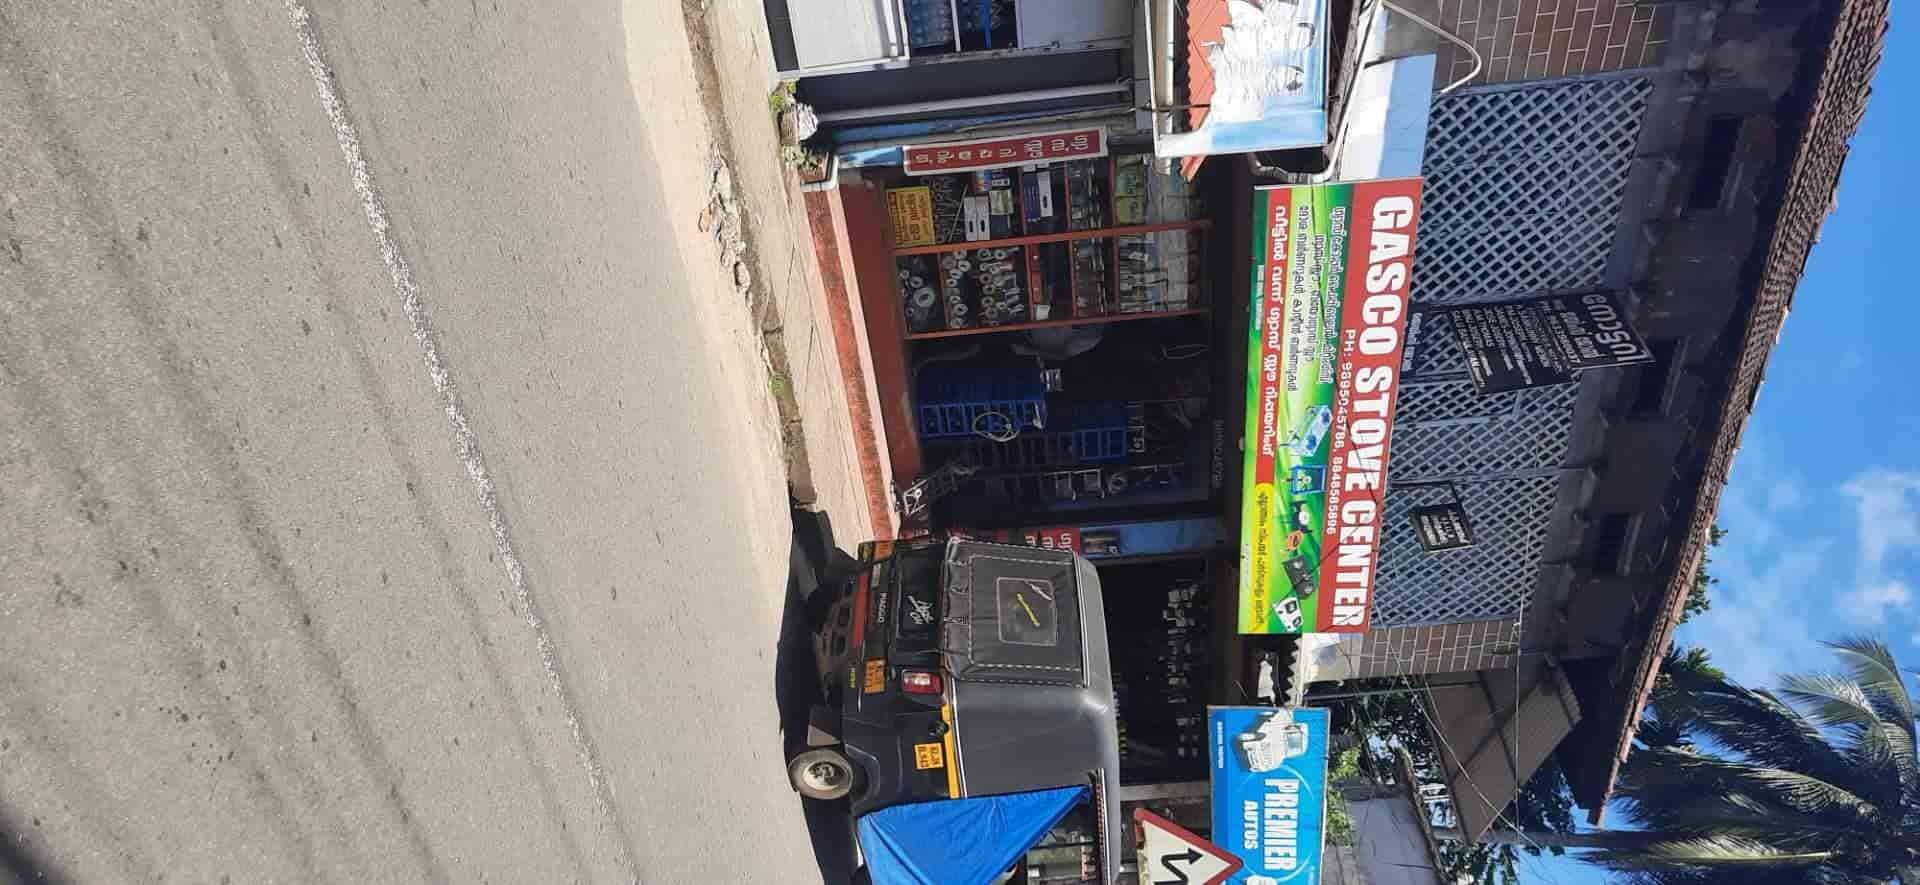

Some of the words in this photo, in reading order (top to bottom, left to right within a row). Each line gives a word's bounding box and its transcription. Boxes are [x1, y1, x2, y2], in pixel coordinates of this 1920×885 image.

[1271, 206, 1288, 260] വീട്ടിൽ
[1270, 266, 1284, 304] വന്ന്
[1359, 196, 1414, 355] GASCO
[1266, 307, 1282, 351] ഗ്യാസ്
[1342, 329, 1356, 357] PH:
[1346, 366, 1396, 490] STOVE
[1331, 500, 1379, 627] CENTER
[1243, 800, 1259, 850] AUTOS
[1263, 778, 1299, 870] PREMIER
